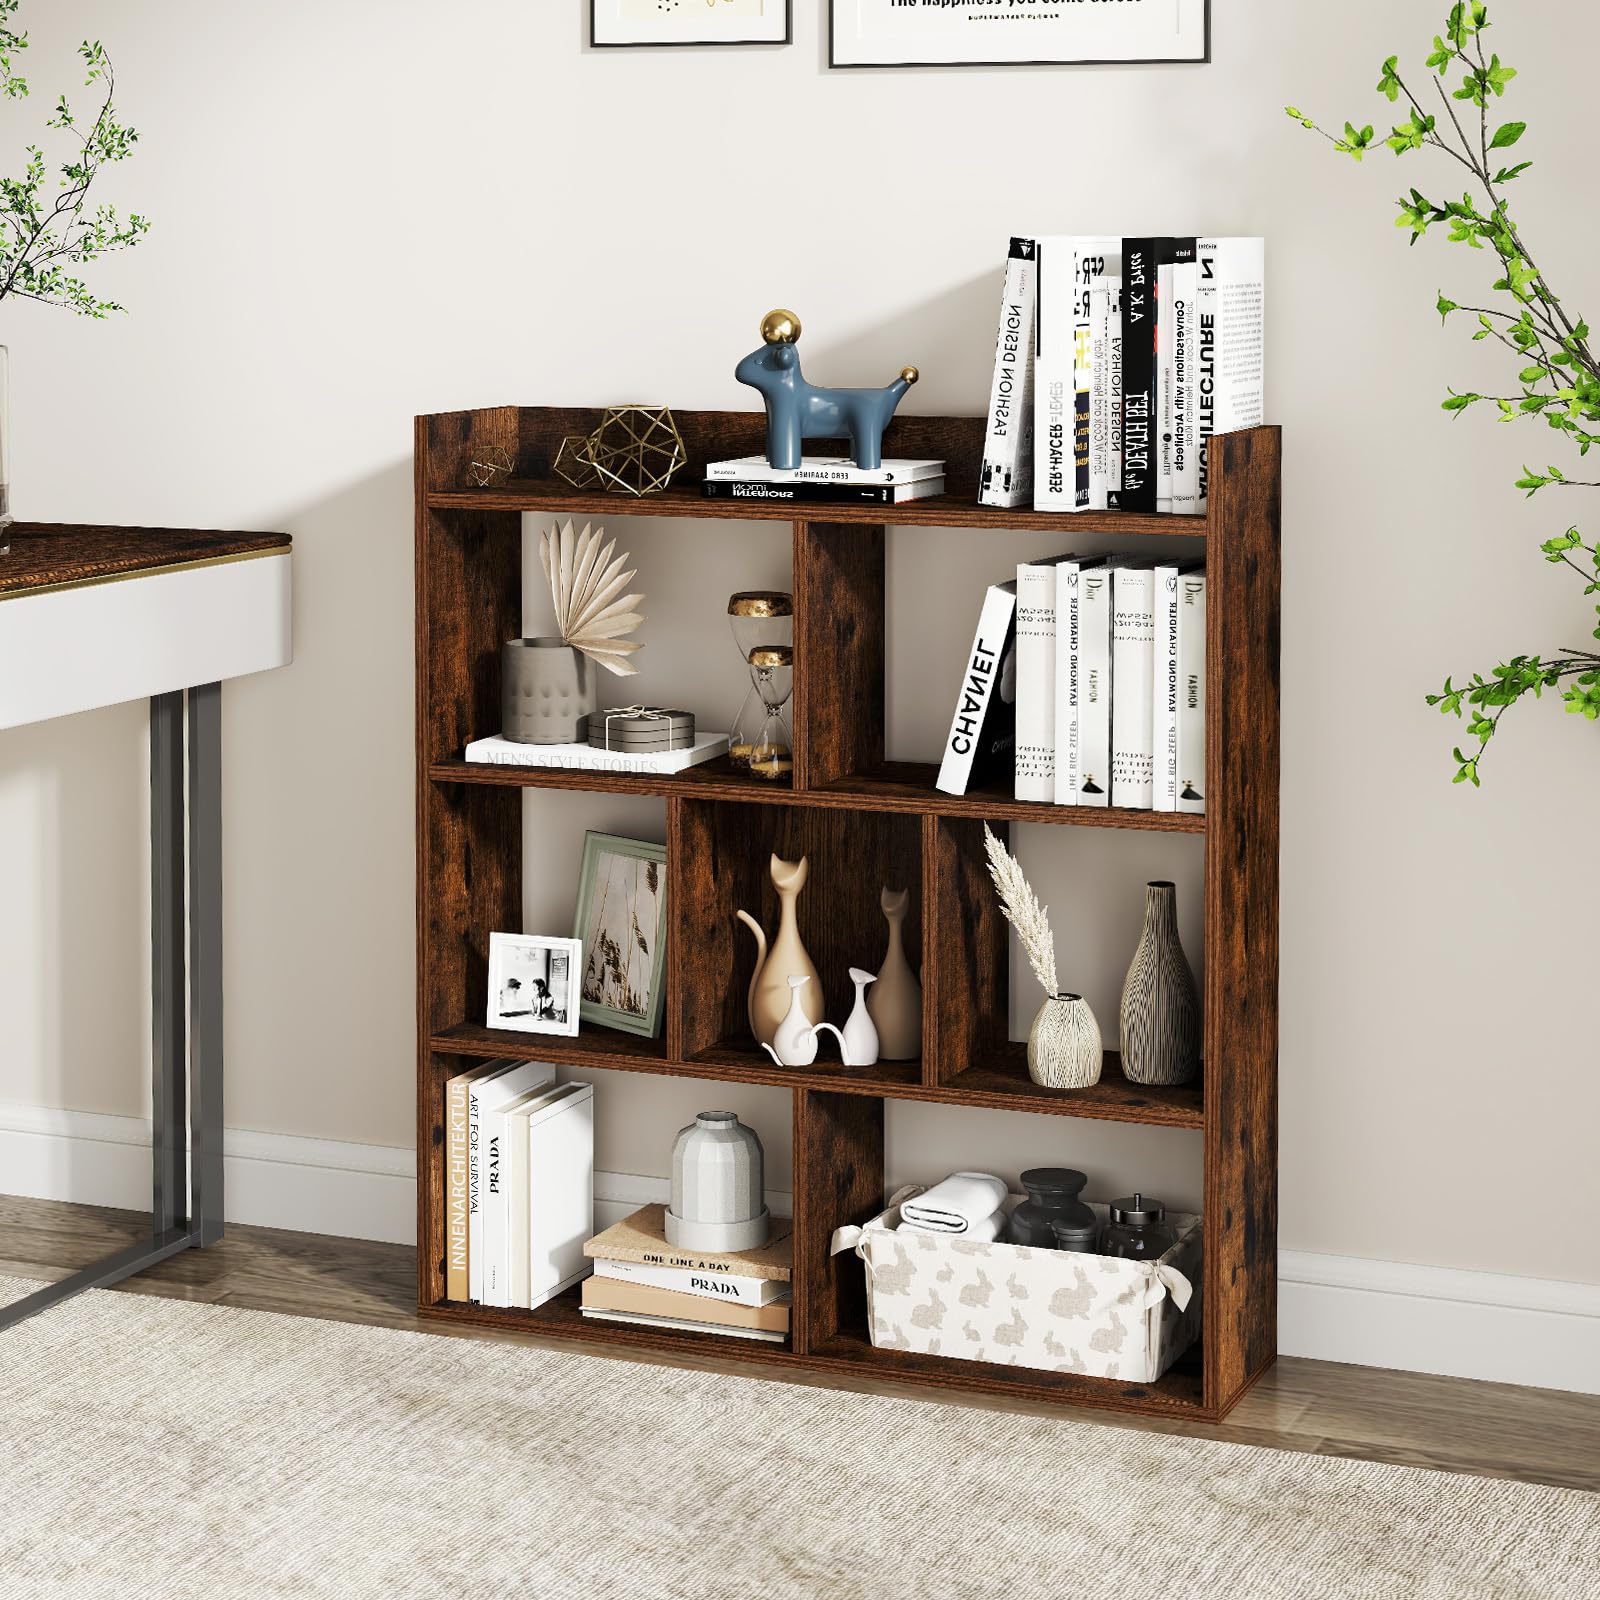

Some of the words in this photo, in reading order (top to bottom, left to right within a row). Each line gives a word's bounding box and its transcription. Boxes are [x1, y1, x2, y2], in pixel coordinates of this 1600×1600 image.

[1086, 578, 1103, 600] Dior
[1185, 582, 1203, 605] Dior
[1188, 675, 1198, 708] FASHION
[470, 1094, 479, 1119] ART
[470, 1124, 479, 1151] FOR
[452, 1083, 465, 1271] INNENARCHITEKTUR
[490, 1136, 499, 1193] PRADA
[470, 1155, 478, 1215] SURVIVAL
[643, 1254, 665, 1264] ONE
[670, 1258, 694, 1268] LINE
[698, 1261, 706, 1269] A
[708, 1262, 730, 1272] DAY
[691, 1277, 740, 1296] PRADA
